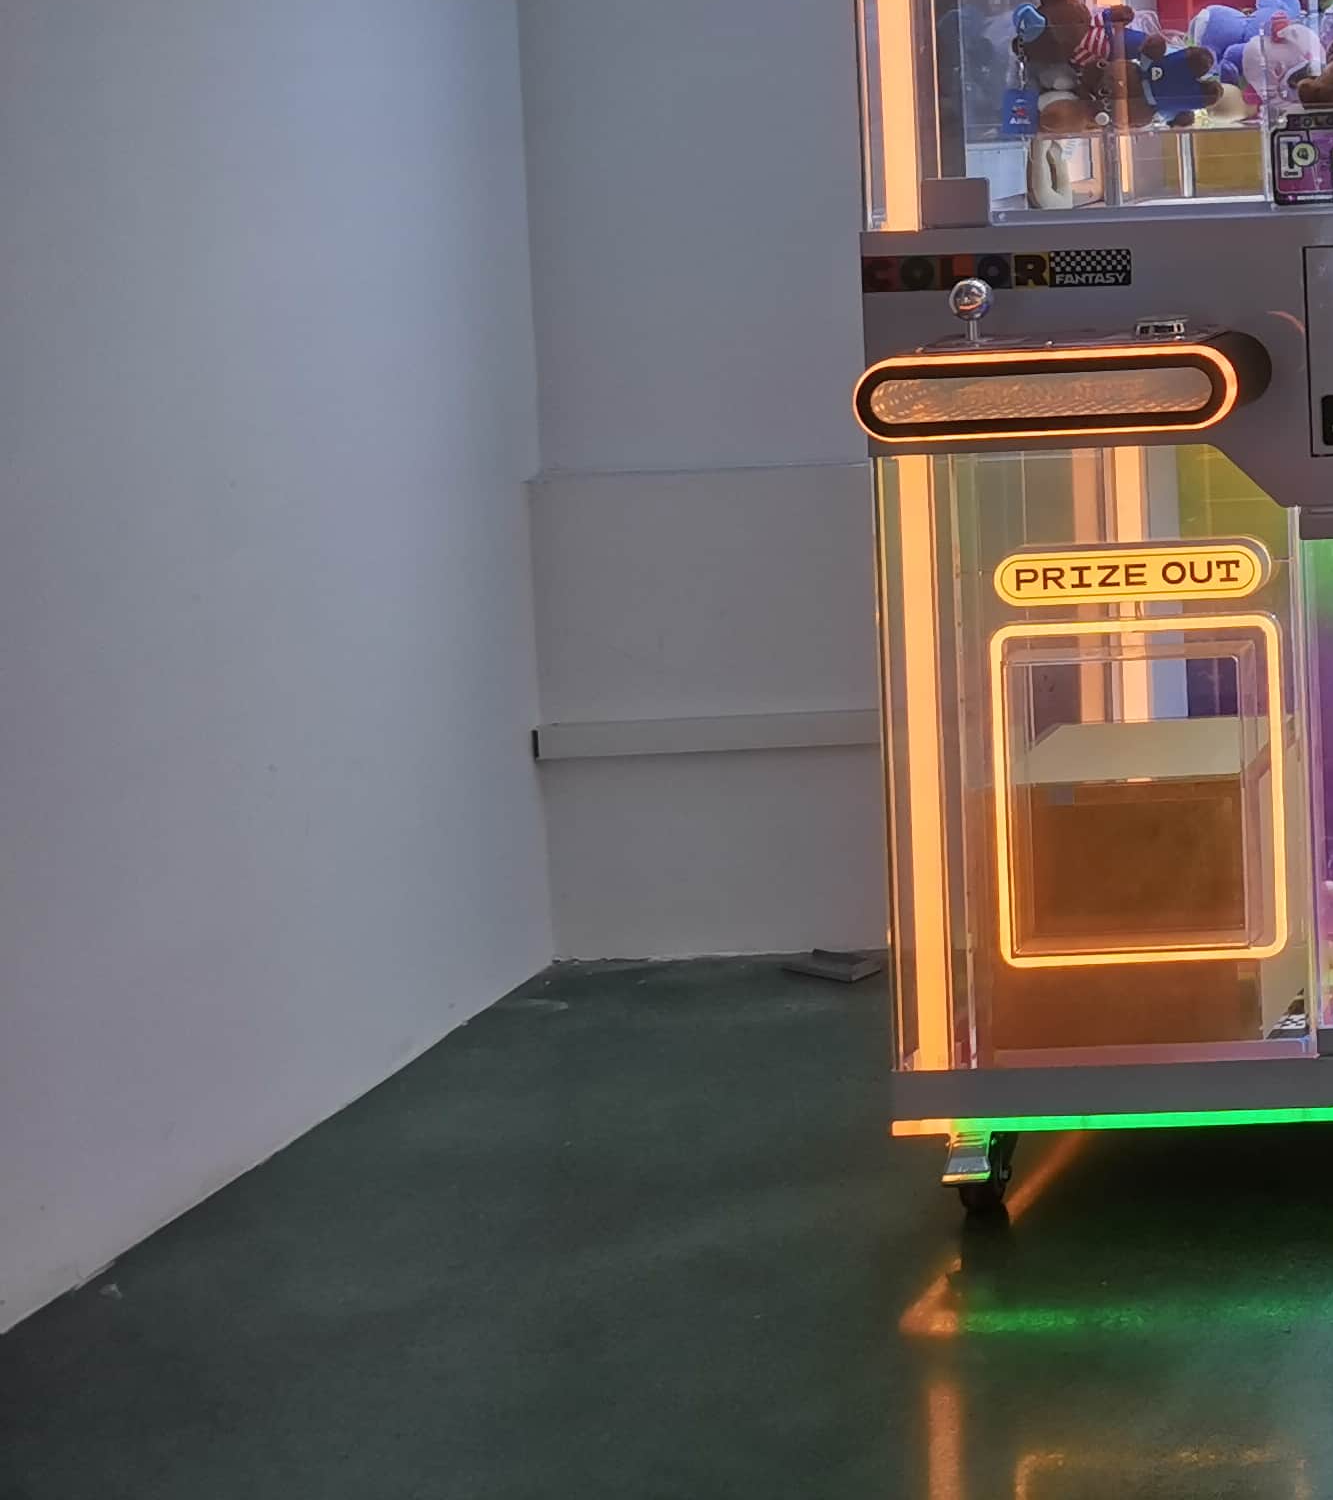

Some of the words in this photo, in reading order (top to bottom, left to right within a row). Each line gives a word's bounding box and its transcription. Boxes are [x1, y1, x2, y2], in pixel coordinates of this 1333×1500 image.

[864, 253, 1048, 291] COLOR
[1055, 271, 1126, 285] FANTASY
[1014, 562, 1148, 591] PRIZE
[1161, 559, 1242, 585] OUT
